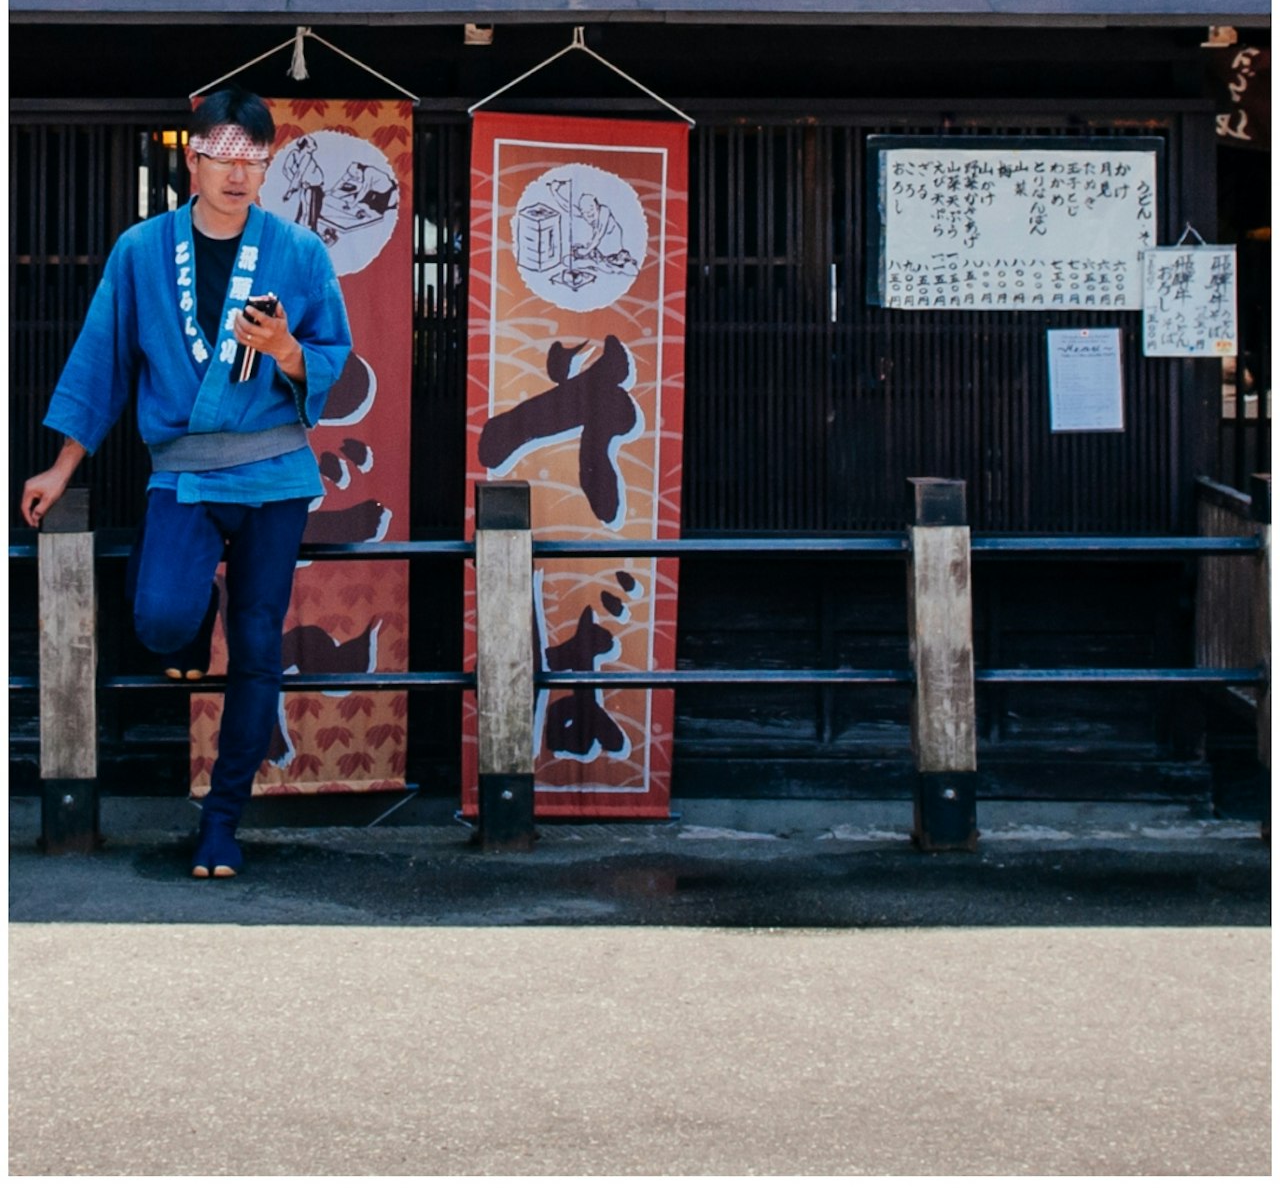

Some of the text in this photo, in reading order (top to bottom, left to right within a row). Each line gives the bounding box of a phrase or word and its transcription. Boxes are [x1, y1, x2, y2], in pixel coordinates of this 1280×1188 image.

[892, 162, 904, 215] おろし
[917, 161, 933, 201] ざる
[978, 162, 996, 206] 山かけ
[1050, 162, 1065, 206] わかめ
[1066, 162, 1081, 217] 玉子とじ
[1083, 161, 1097, 210] たぬき
[1096, 161, 1112, 199] 月見
[1114, 163, 1131, 200] かけ
